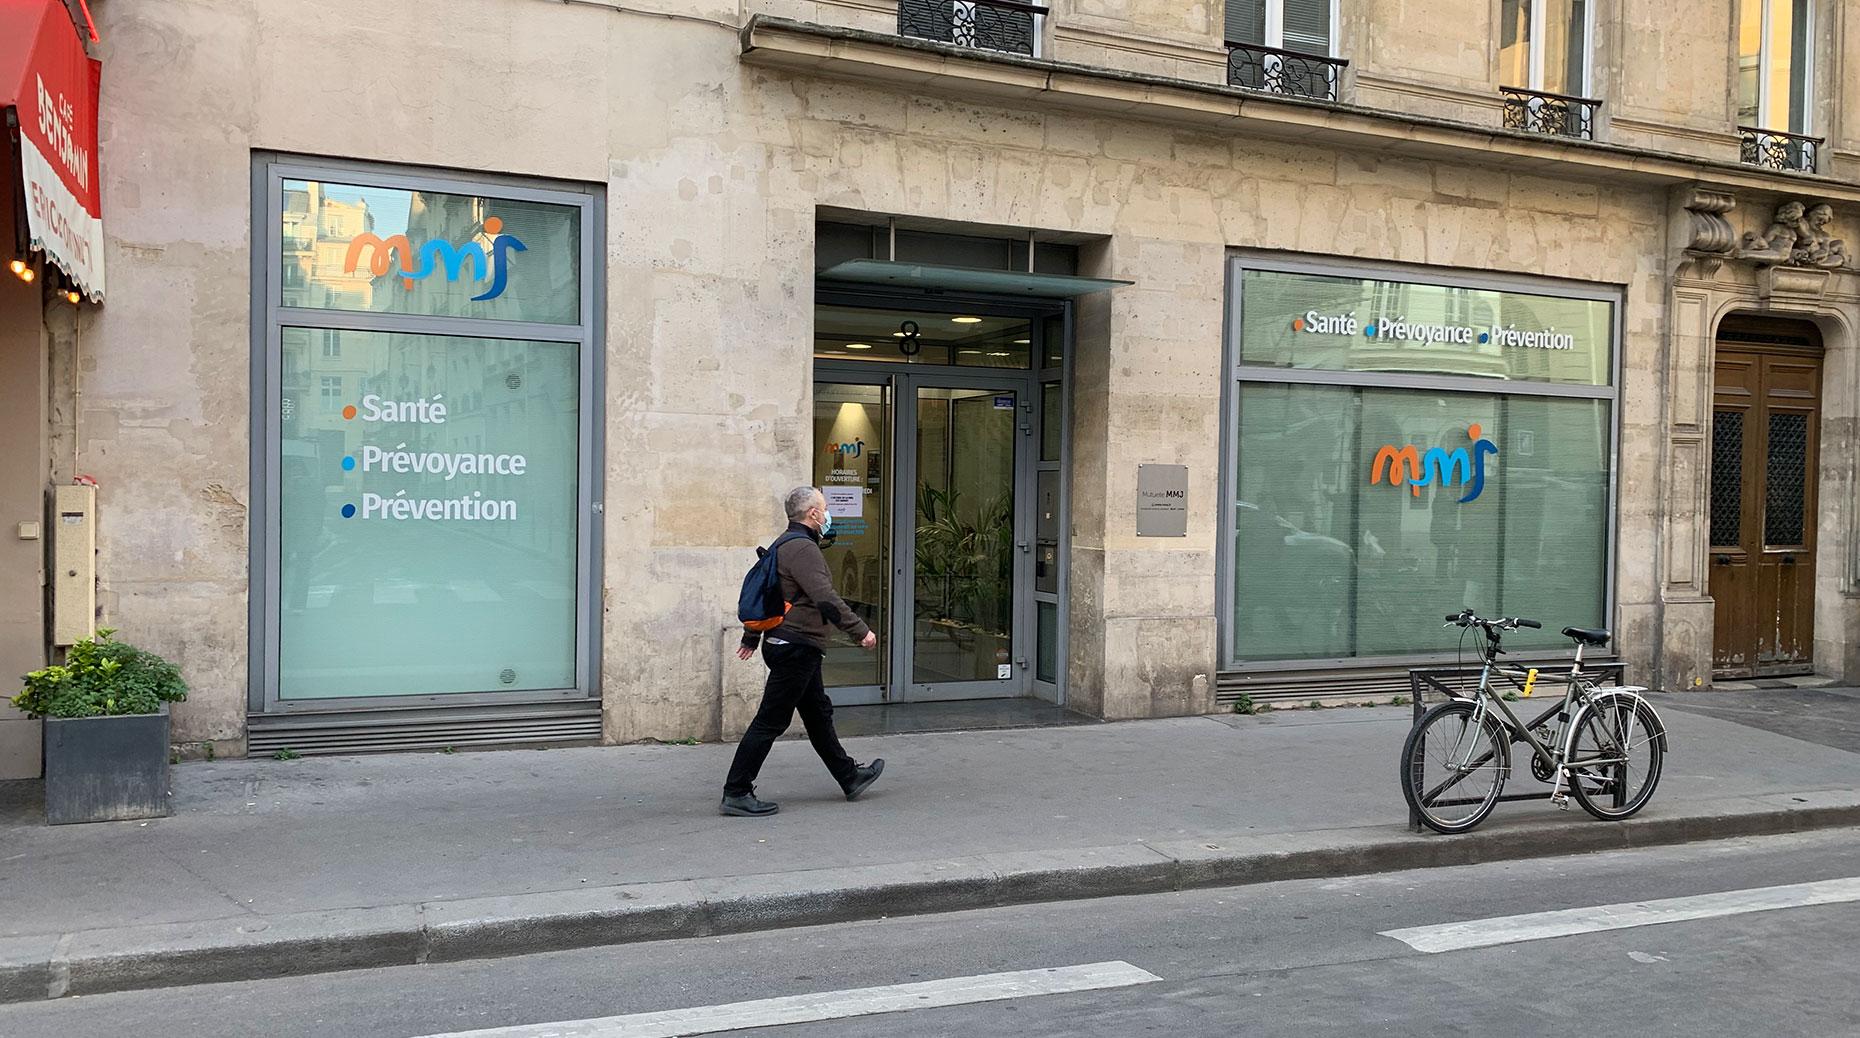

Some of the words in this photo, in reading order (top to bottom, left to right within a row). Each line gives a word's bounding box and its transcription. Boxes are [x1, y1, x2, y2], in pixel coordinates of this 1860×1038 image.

[37, 72, 88, 193] BENJAMIN
[900, 320, 920, 355] 8
[1306, 311, 1357, 336] Santé
[1378, 316, 1473, 347] Prévoyance
[1492, 324, 1574, 350] Prévention
[362, 394, 447, 424] Santé
[362, 443, 527, 480] Prévoyance
[362, 490, 517, 521] Prévention
[1166, 490, 1183, 498] MMJ
